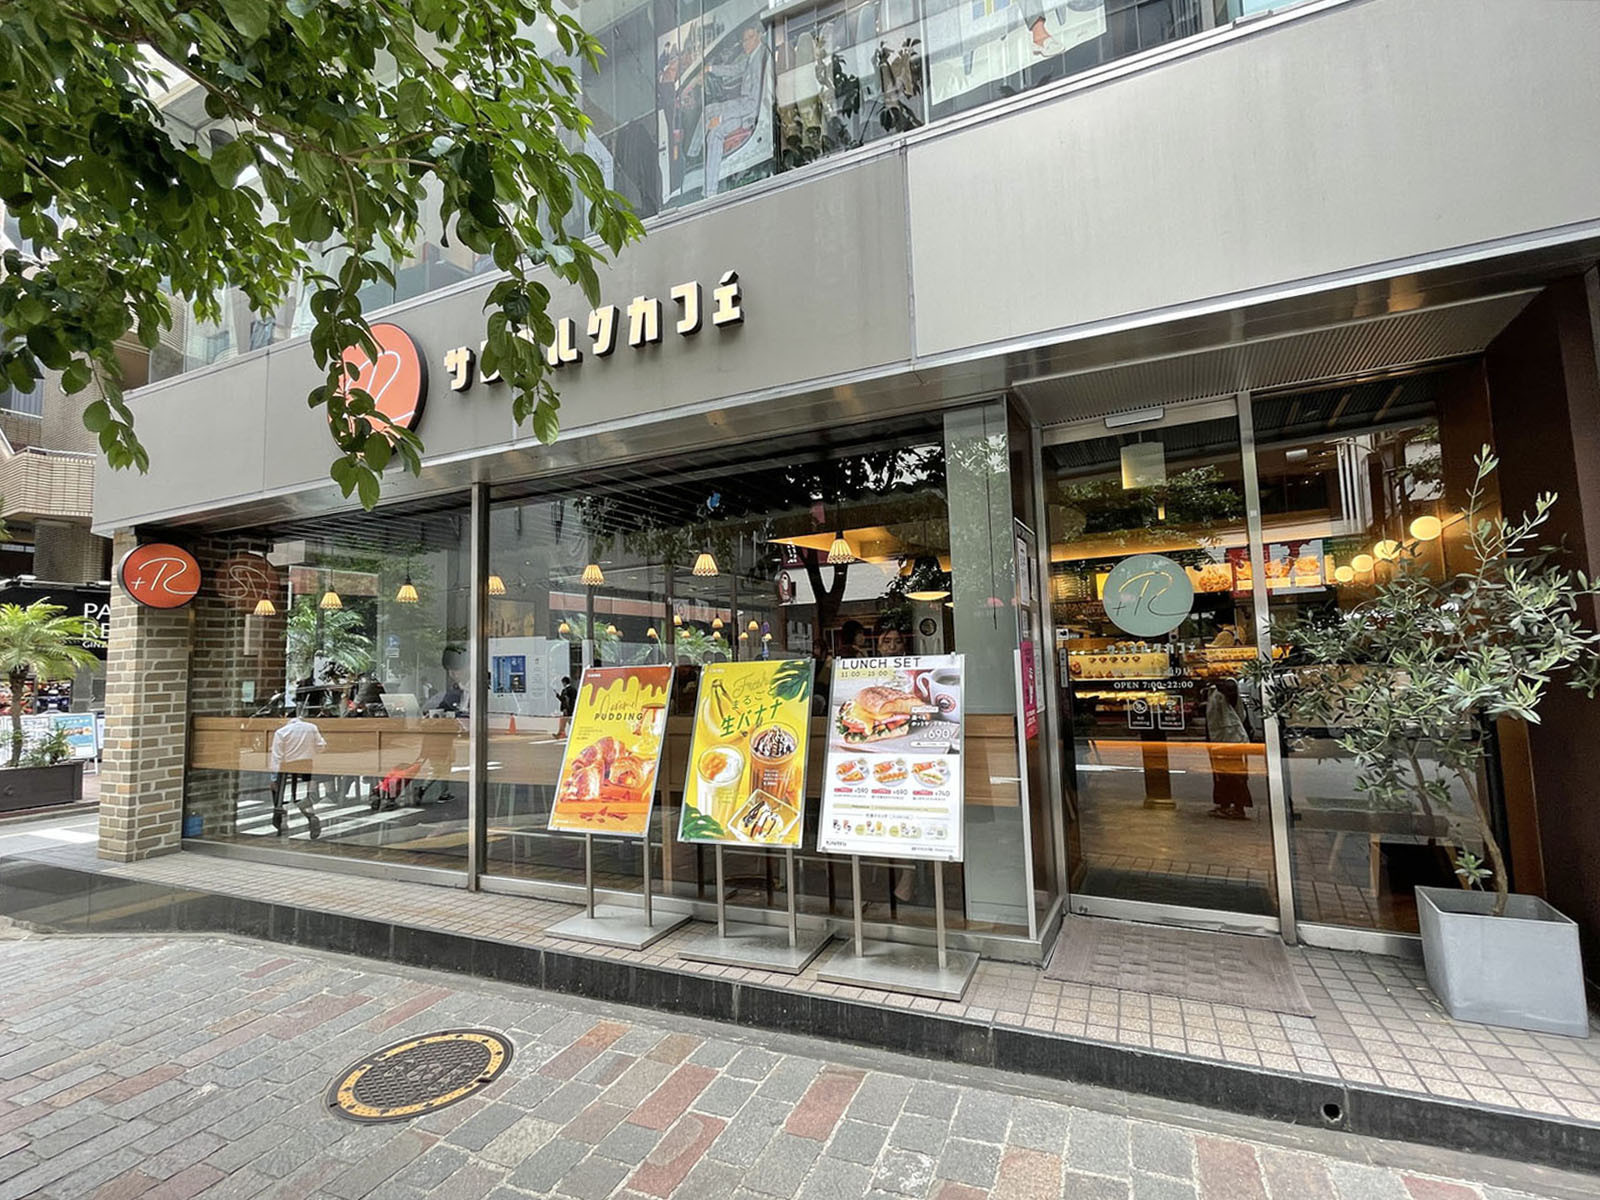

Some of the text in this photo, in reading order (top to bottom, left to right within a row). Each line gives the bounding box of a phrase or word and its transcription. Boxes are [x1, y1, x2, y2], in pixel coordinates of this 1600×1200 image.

[443, 269, 743, 392] サルクカフェ
[841, 657, 921, 670] LUNCH SET
[1113, 681, 1140, 689] OPEN
[593, 712, 643, 721] PUDDING
[719, 699, 783, 737] 生バナナ
